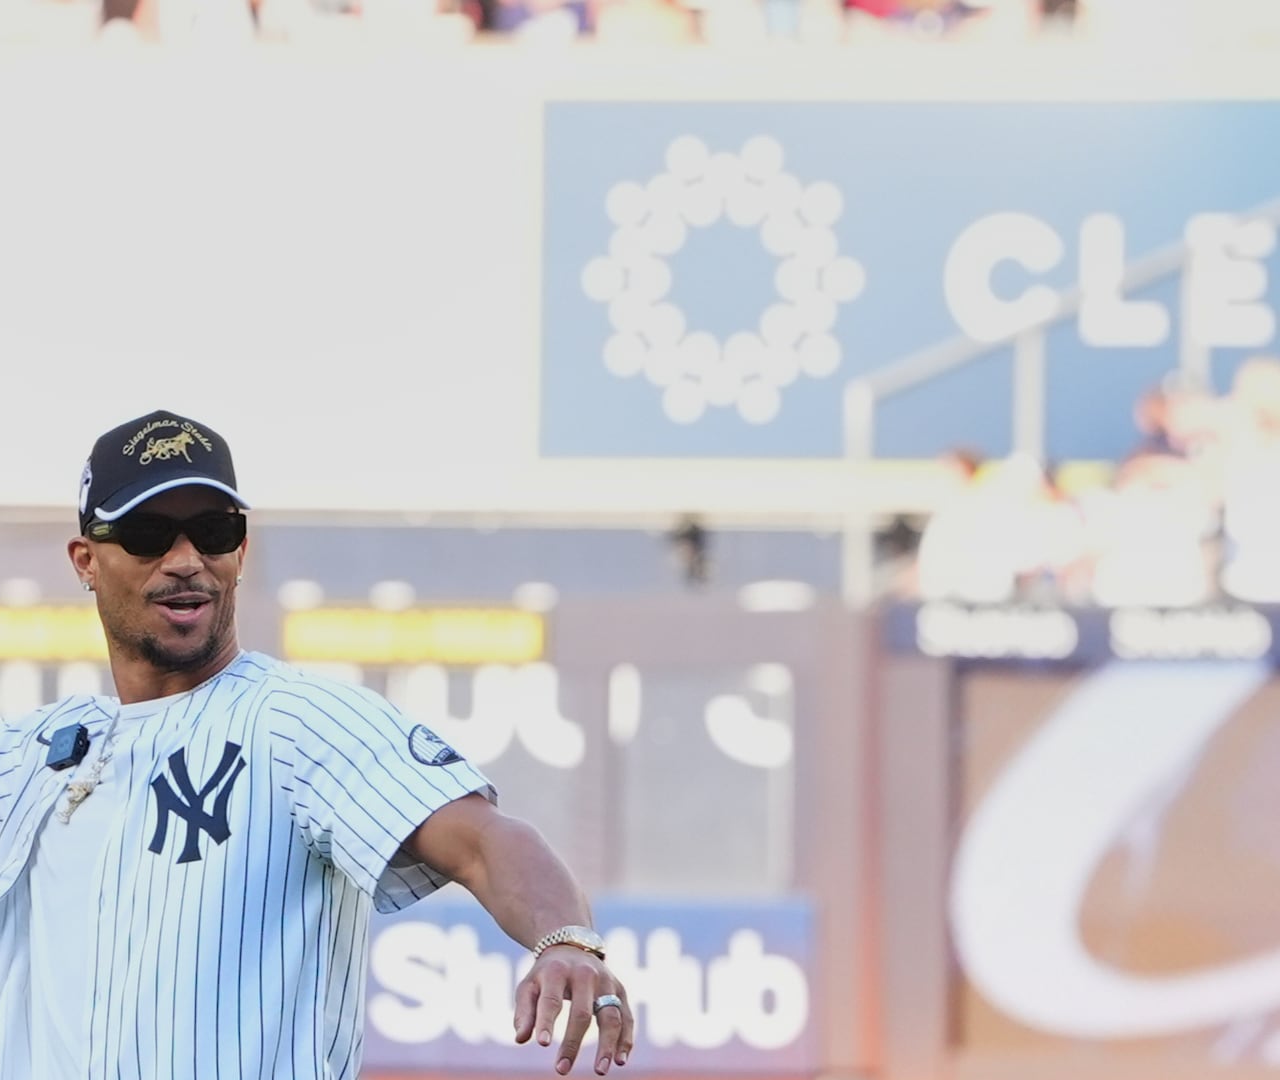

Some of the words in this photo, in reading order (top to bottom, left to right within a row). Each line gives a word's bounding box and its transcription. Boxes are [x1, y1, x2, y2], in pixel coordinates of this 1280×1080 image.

[944, 211, 1276, 346] CLE
[122, 419, 179, 456] Siegelman
[369, 921, 809, 1050] StuHub
